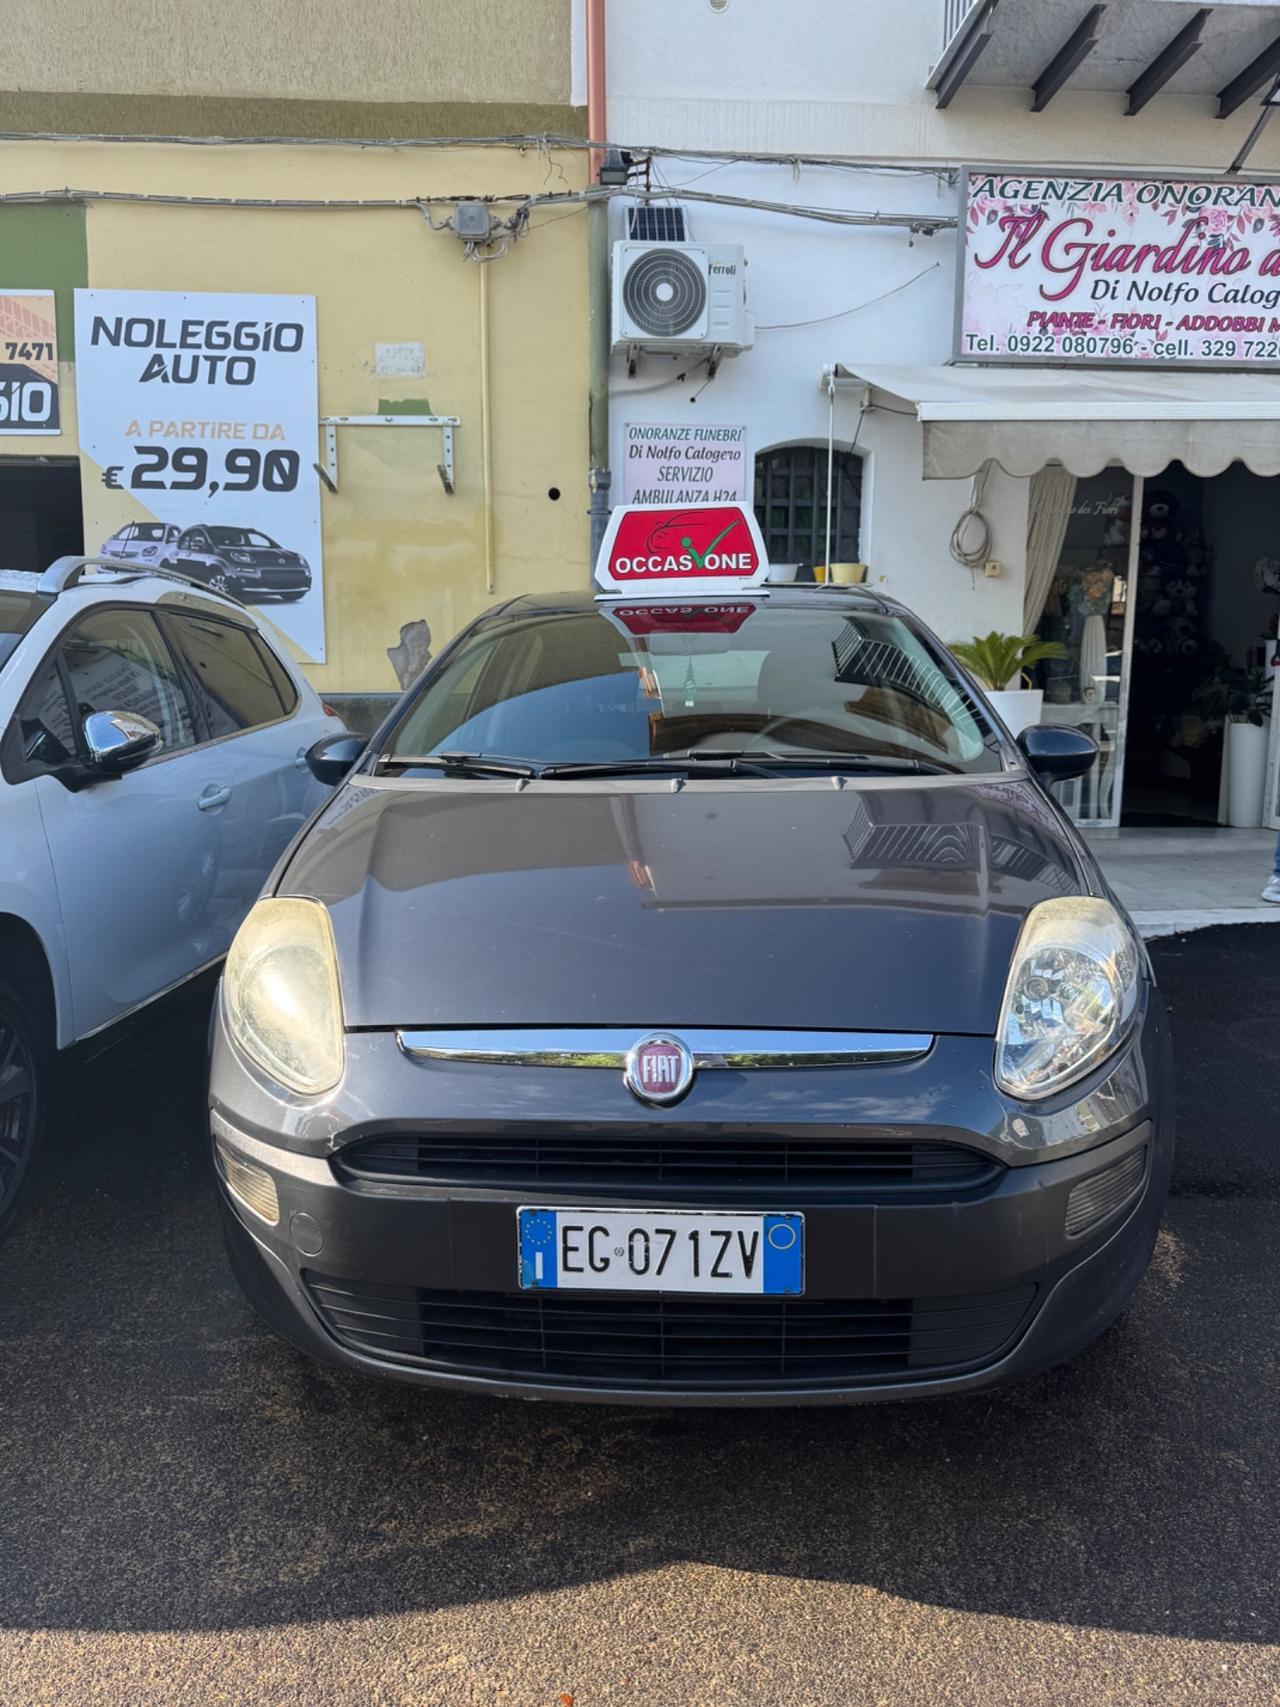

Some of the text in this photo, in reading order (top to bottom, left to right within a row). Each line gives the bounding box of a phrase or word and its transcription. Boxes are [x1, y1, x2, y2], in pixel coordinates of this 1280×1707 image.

[972, 179, 1280, 208] AGENZIA ONORAN
[974, 210, 1047, 269] Il
[1039, 216, 1251, 301] Giardino
[708, 263, 736, 275] Ferroli
[1091, 279, 1280, 310] Di Nolfo Calog
[1026, 311, 1095, 328] PIANTE
[1110, 313, 1162, 330] FIORI
[1176, 315, 1265, 333] ADDOBBI
[5, 342, 53, 360] 7471
[966, 334, 999, 351] Tel.
[1008, 335, 1054, 352] 0922
[1062, 336, 1133, 356] 080796
[1154, 340, 1193, 356] cell.
[1202, 341, 1236, 357] 329
[1244, 341, 1280, 358] 722
[138, 353, 256, 386] AUTO
[125, 420, 142, 437] A
[252, 423, 286, 441] DA
[629, 427, 742, 442] ONORANZE FUNEBRI
[629, 445, 741, 463] Di Nolfo Calogero
[657, 465, 713, 483] SERVIZIO
[631, 489, 709, 504] AMBULANZA
[642, 1055, 679, 1083] FIAT
